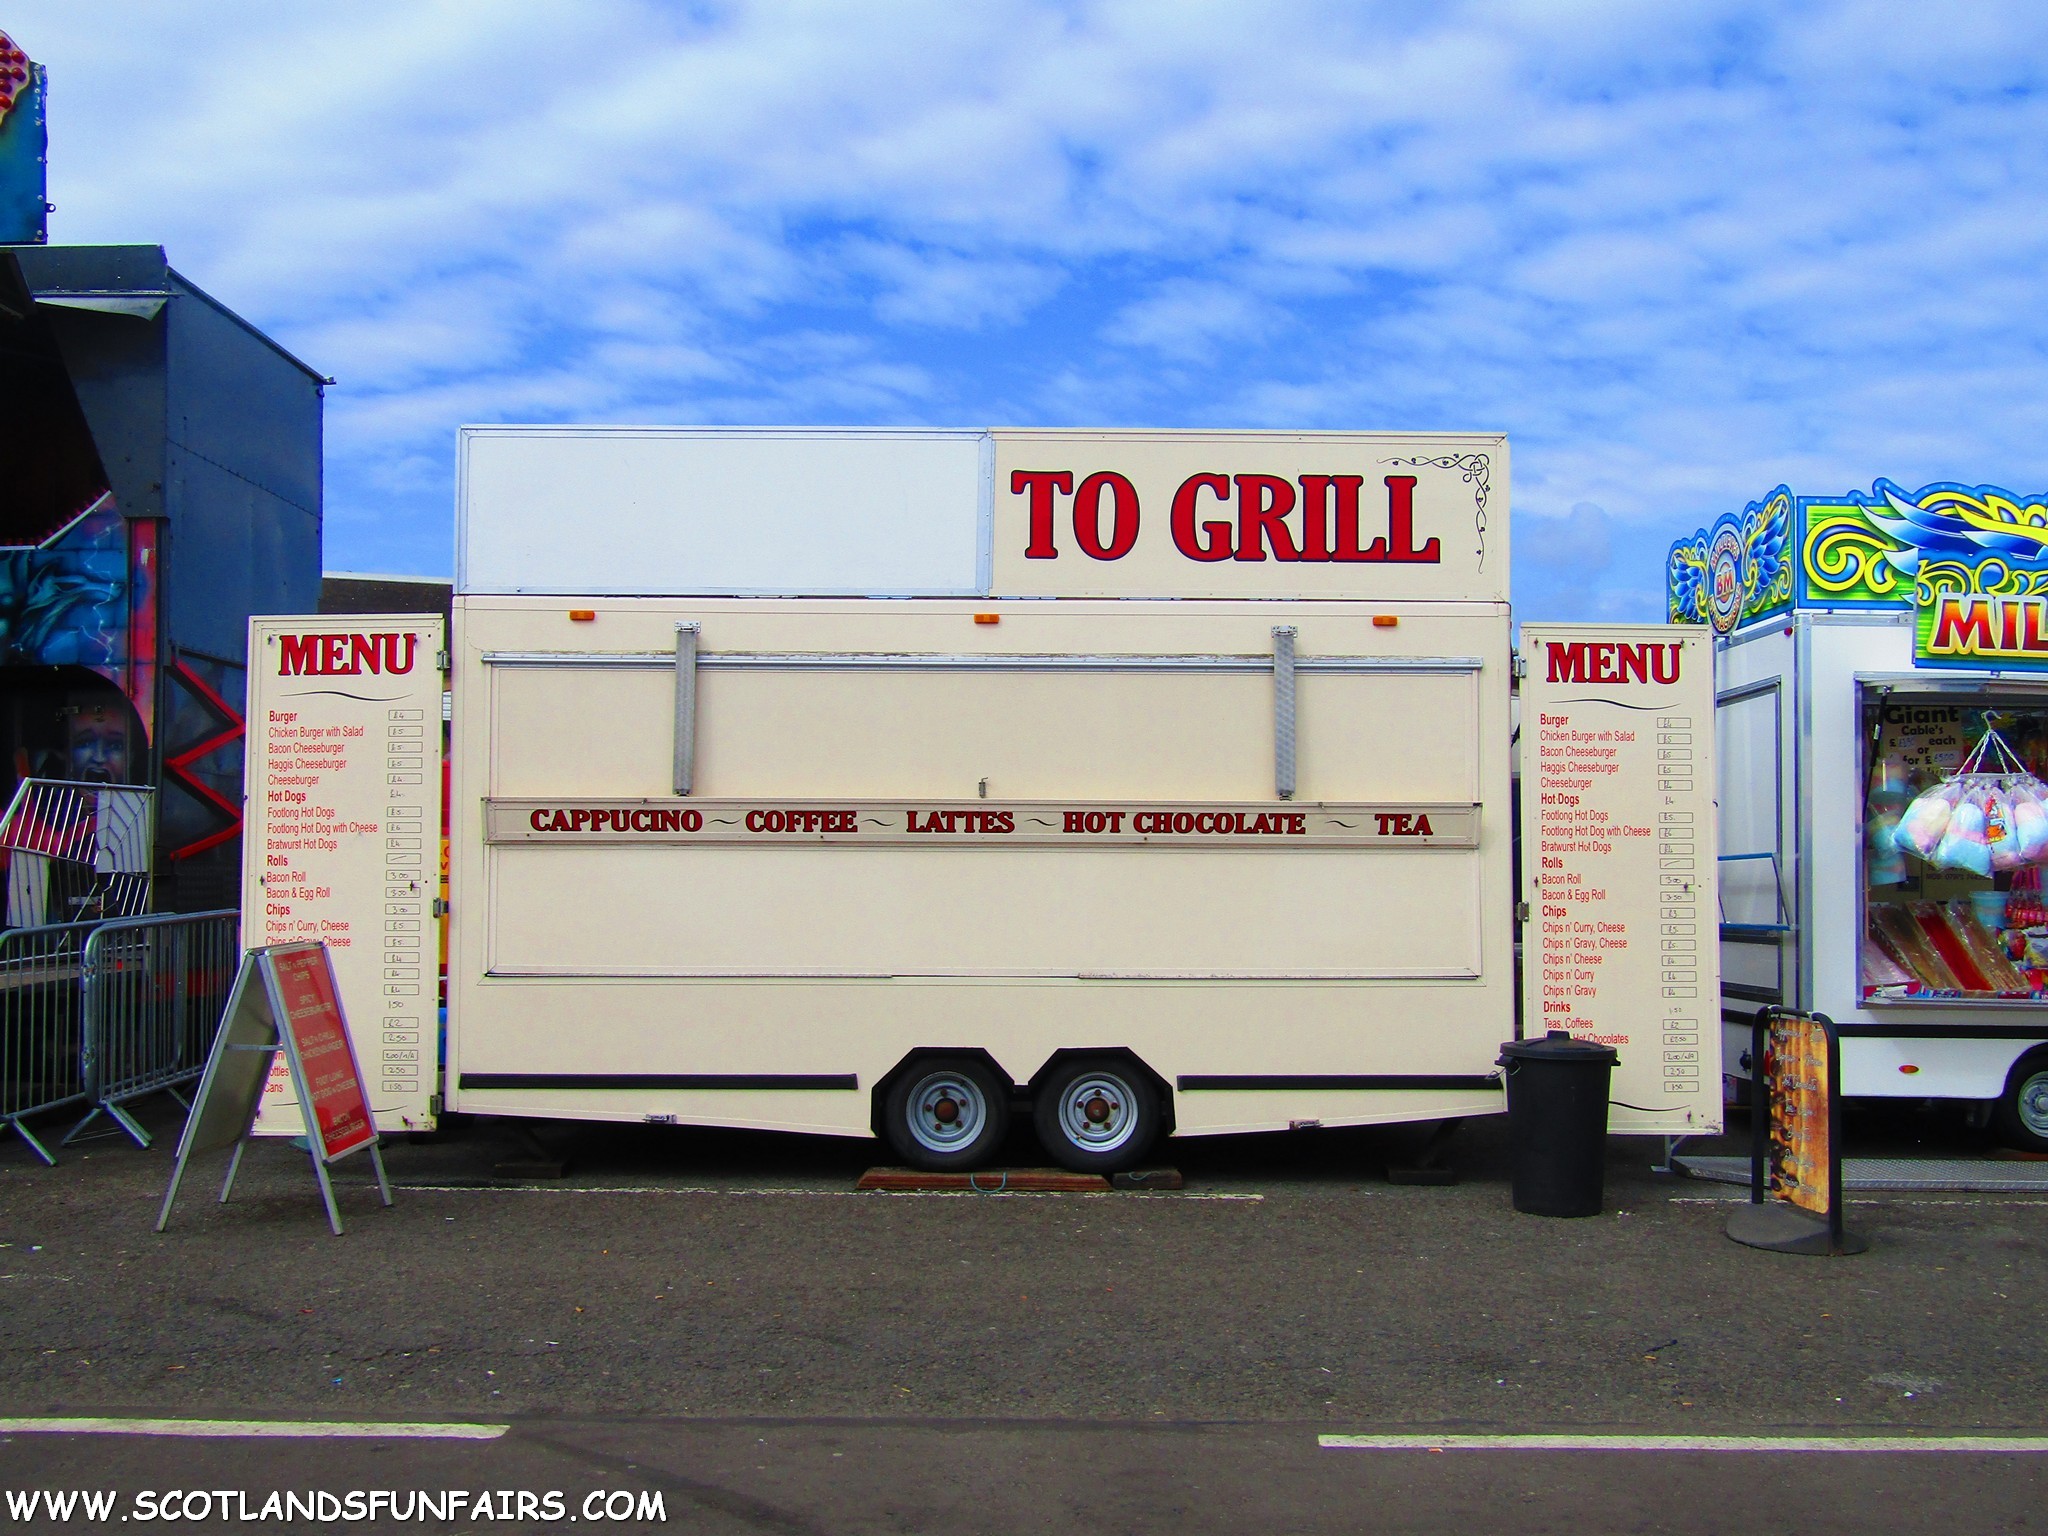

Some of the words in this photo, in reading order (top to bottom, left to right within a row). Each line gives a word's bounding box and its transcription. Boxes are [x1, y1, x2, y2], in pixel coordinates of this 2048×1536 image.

[1011, 470, 1140, 562] TO
[1170, 471, 1441, 563] GRILL
[1716, 569, 1734, 597] BM
[1932, 597, 2048, 653] MIL
[278, 633, 416, 676] MENU
[1546, 642, 1682, 684] MENU
[269, 710, 298, 725] Burger
[1540, 713, 1569, 728] Burger
[1885, 706, 1959, 724] Giant
[269, 726, 298, 738] Chicken
[300, 726, 324, 741] Burger
[326, 726, 341, 738] with
[343, 726, 364, 738] Salad
[1541, 730, 1570, 742] Chicken
[1571, 730, 1596, 744] Burger
[1597, 730, 1612, 742] with
[1614, 730, 1635, 742] Salad
[1901, 725, 1944, 735] Cable's
[1929, 735, 1956, 745] each
[268, 743, 292, 755] Bacon
[293, 743, 345, 757] Cheeseburger
[1540, 746, 1564, 758] Bacon
[1565, 746, 1617, 760] Cheeseburger
[1917, 746, 1930, 754] or
[268, 758, 295, 772] Haggis
[295, 758, 347, 772] Cheeseburger
[1540, 762, 1567, 776] Haggis
[1567, 762, 1619, 776] Cheeseburger
[269, 774, 320, 788] Cheeseburger
[1540, 777, 1593, 791] Cheeseburger
[267, 790, 283, 802] Hot
[284, 790, 307, 805] Dogs
[1540, 793, 1556, 805] Hot
[1558, 793, 1580, 808] Dogs
[268, 806, 300, 821] Footlong
[301, 806, 315, 818] Hot
[315, 806, 335, 821] Dogs
[1541, 810, 1573, 824] Footlong
[1575, 810, 1588, 822] Hot
[1589, 810, 1609, 824] Dogs
[267, 822, 298, 836] Footlong
[300, 822, 313, 834] Hot
[314, 822, 332, 836] Dog
[332, 822, 348, 834] with
[351, 822, 378, 834] Cheese
[531, 809, 703, 832] CAPPUCINO
[745, 810, 858, 833] COFFEE
[906, 811, 1015, 834] LATTES
[1062, 811, 1126, 834] HOT
[1133, 812, 1306, 835] CHOCOLATE
[1374, 813, 1433, 836] TEA
[1541, 825, 1573, 840] Footlong
[1574, 825, 1588, 837] Hot
[1589, 825, 1605, 840] Dog
[1606, 825, 1622, 837] with
[1623, 825, 1651, 837] Cheese
[267, 838, 300, 850] Bratwurst
[301, 838, 316, 850] Hot
[317, 838, 338, 852] Dogs
[1541, 841, 1577, 853] Bratwurst
[1577, 841, 1591, 853] Hot
[1592, 841, 1612, 856] Dogs
[266, 855, 289, 866] Rolls
[1541, 857, 1564, 869] Rolls
[266, 871, 289, 883] Bacon
[290, 871, 306, 883] Roll
[1541, 874, 1566, 885] Bacon
[1567, 874, 1582, 885] Roll
[266, 887, 289, 899] Bacon
[291, 887, 297, 899] &
[299, 887, 315, 901] Egg
[316, 887, 331, 899] Roll
[1541, 889, 1566, 901] Bacon
[1567, 889, 1573, 901] &
[1575, 889, 1591, 903] Egg
[1591, 889, 1606, 901] Roll
[265, 903, 291, 918] Chips
[1542, 905, 1567, 920] Chips
[266, 920, 285, 934] Chips
[321, 920, 350, 932] Cheese
[1542, 922, 1565, 936] Chips
[1597, 922, 1626, 934] Cheese
[323, 935, 351, 947] Cheese
[1543, 938, 1565, 952] Chips
[1599, 938, 1628, 950] Cheese
[1543, 954, 1565, 968] Chips
[1574, 954, 1603, 966] Cheese
[1542, 969, 1565, 984] Chips
[1574, 969, 1595, 984] Curry
[1542, 985, 1565, 1000] Chips
[1574, 985, 1597, 1000] Gravy
[1543, 1001, 1571, 1013] Drinks
[1565, 1018, 1594, 1030] Coffees
[1588, 1033, 1629, 1044] Chocolates
[270, 1065, 290, 1077] ottles
